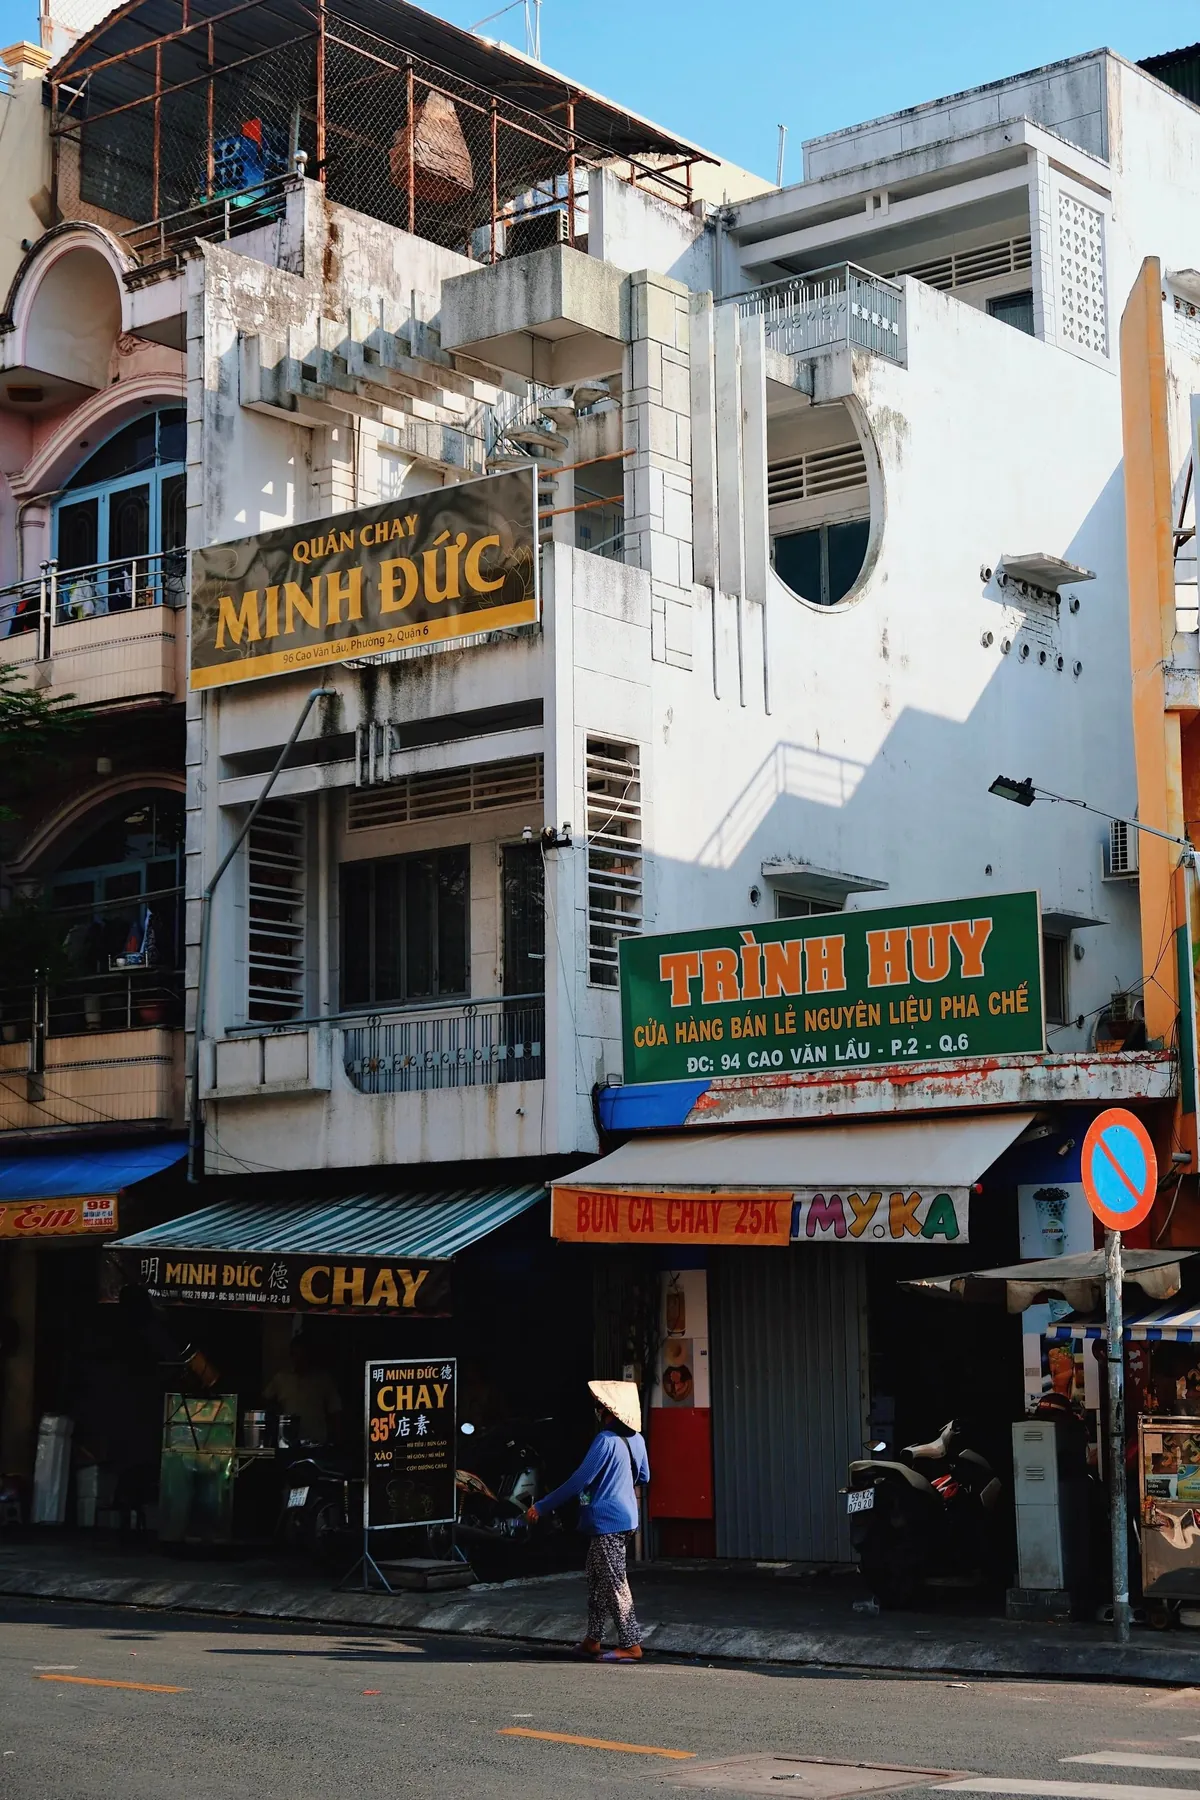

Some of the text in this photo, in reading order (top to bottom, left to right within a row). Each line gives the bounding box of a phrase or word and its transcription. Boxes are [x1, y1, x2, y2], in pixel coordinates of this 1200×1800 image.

[292, 513, 419, 564] QUÁN CHAY
[215, 530, 507, 649] MINH ĐỨC
[283, 653, 294, 664] 96
[295, 651, 311, 662] Cao
[351, 635, 385, 651] Phường
[388, 633, 395, 644] 2,
[397, 627, 421, 642] Quận
[423, 625, 429, 636] 6
[659, 917, 993, 1007] TRÌNH HUY
[634, 981, 1029, 1048] CỬA HÀNG BÁN LẺ NGUYÊN LIỆU PHA CHẾ
[687, 1056, 714, 1073] ĐC:
[721, 1053, 740, 1071] 94
[747, 1048, 784, 1068] CAO
[790, 1043, 827, 1065] VĂN
[835, 1037, 870, 1061] LẦU
[891, 1037, 918, 1056] P.2
[939, 1033, 969, 1053] Q.6
[14, 1204, 78, 1231] Em
[87, 1200, 110, 1211] 98
[666, 1200, 724, 1234] CHAY
[734, 1201, 779, 1235] 25K
[140, 1257, 160, 1285] 明
[165, 1260, 263, 1287] MINH ĐỨC
[267, 1261, 289, 1290] 德
[300, 1265, 430, 1308] CHAY
[372, 1368, 384, 1383] 明
[386, 1365, 439, 1381] MINH ĐỨC
[440, 1364, 452, 1380] 德
[377, 1383, 449, 1412] CHAY
[374, 1450, 393, 1461] XÀO
